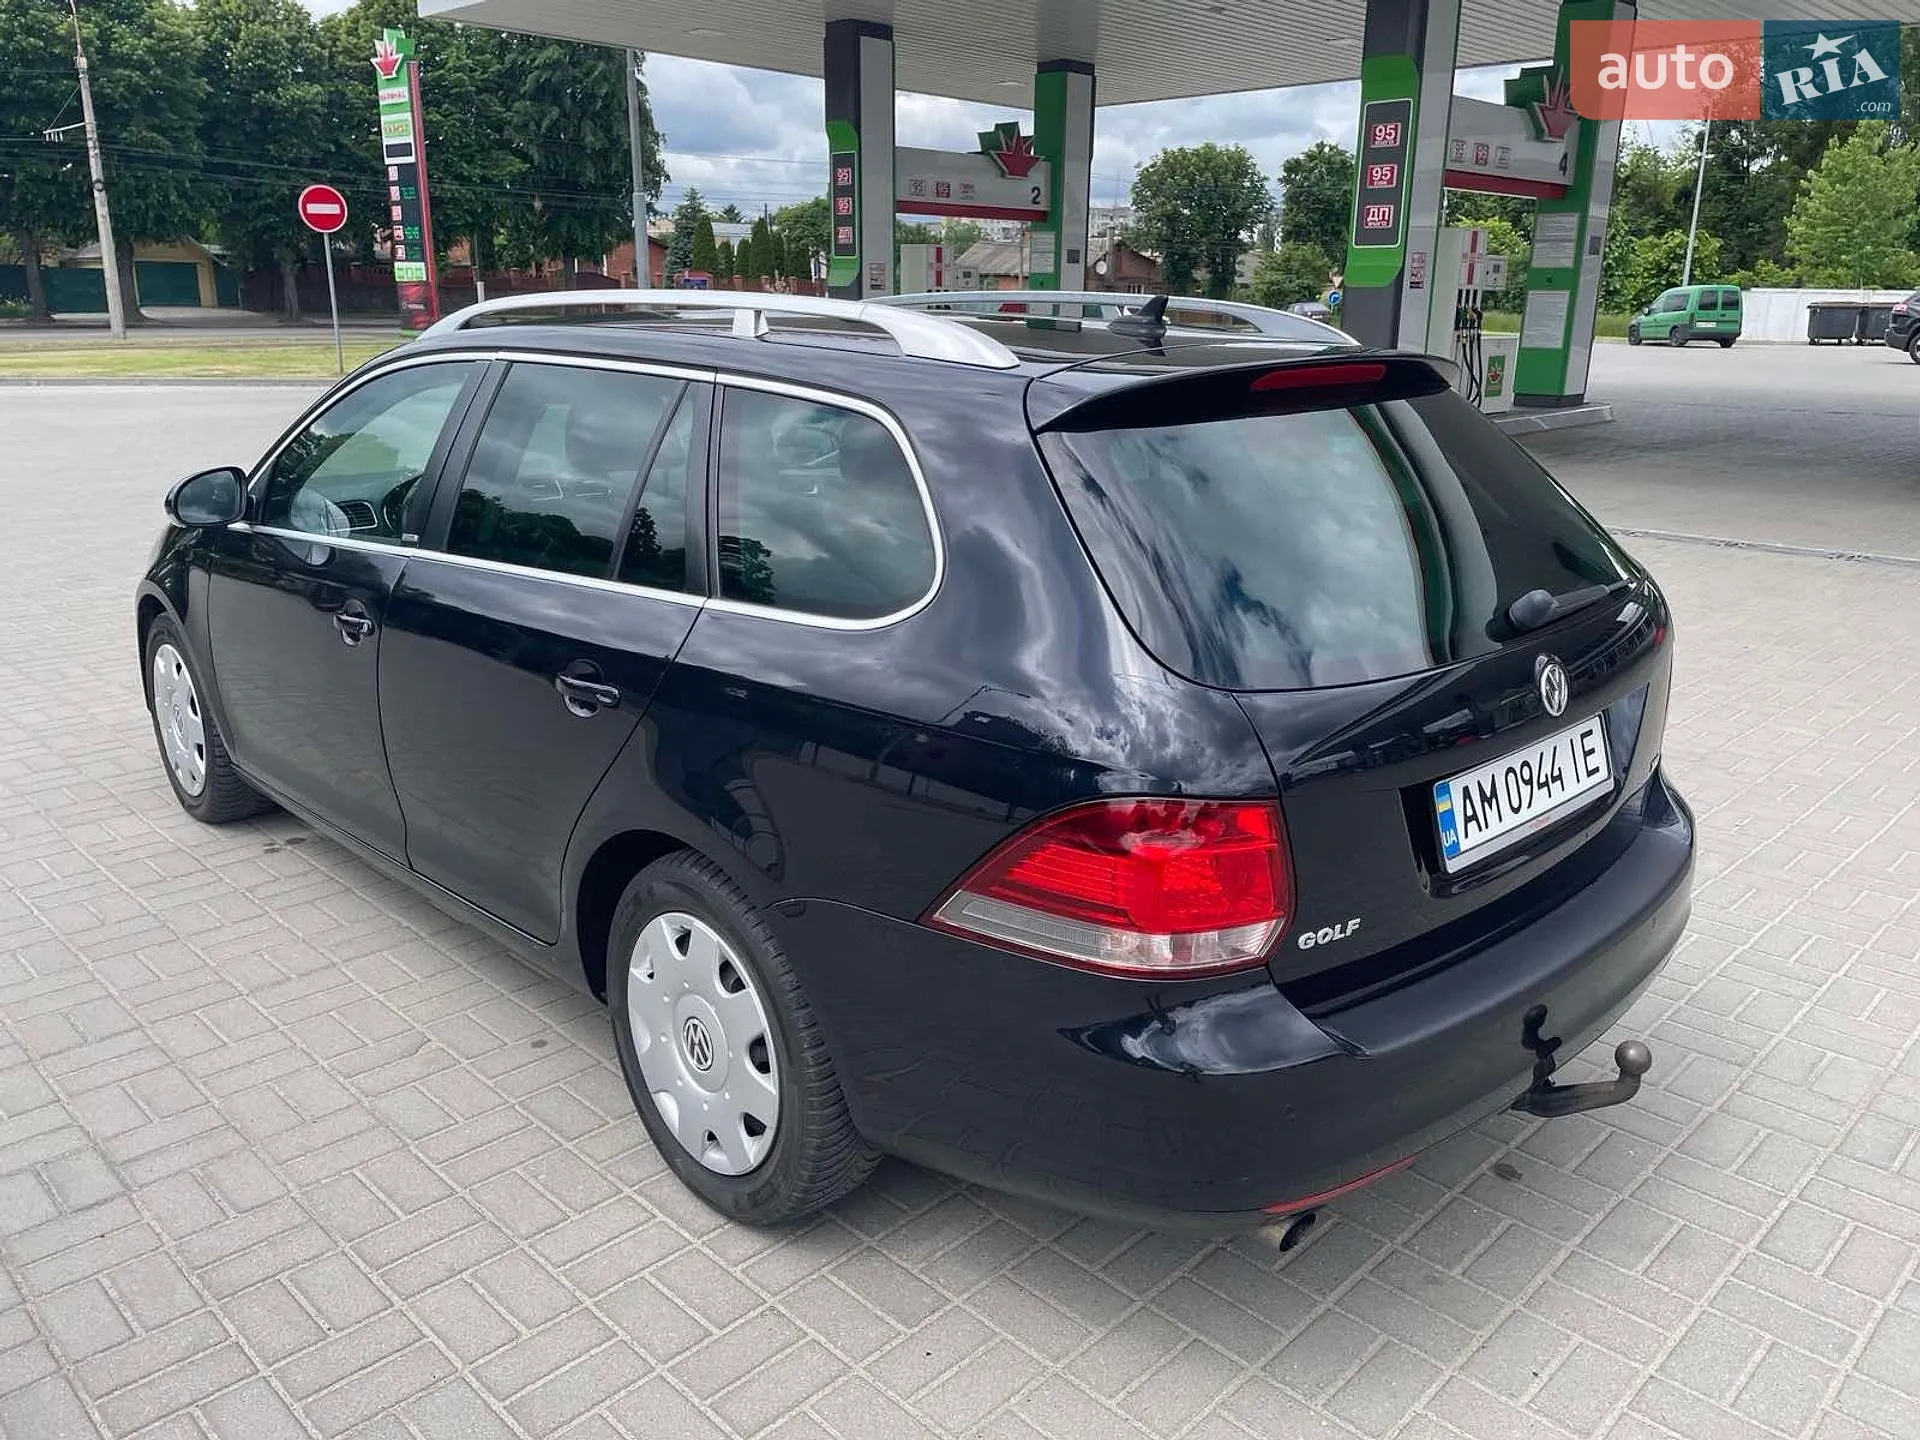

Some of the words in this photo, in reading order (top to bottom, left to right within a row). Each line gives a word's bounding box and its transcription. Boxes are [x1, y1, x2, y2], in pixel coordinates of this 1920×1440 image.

[1375, 124, 1396, 141] 95
[1558, 152, 1568, 177] 4
[836, 168, 849, 181] 95
[1372, 166, 1392, 181] 95
[1031, 186, 1041, 204] 2
[838, 199, 849, 210] 95
[1367, 207, 1389, 221] ДП
[1462, 774, 1503, 839] AM
[1504, 746, 1565, 815] 0944
[1570, 729, 1600, 784] IE
[1443, 832, 1458, 848] UA
[1298, 918, 1361, 950] GOLF
